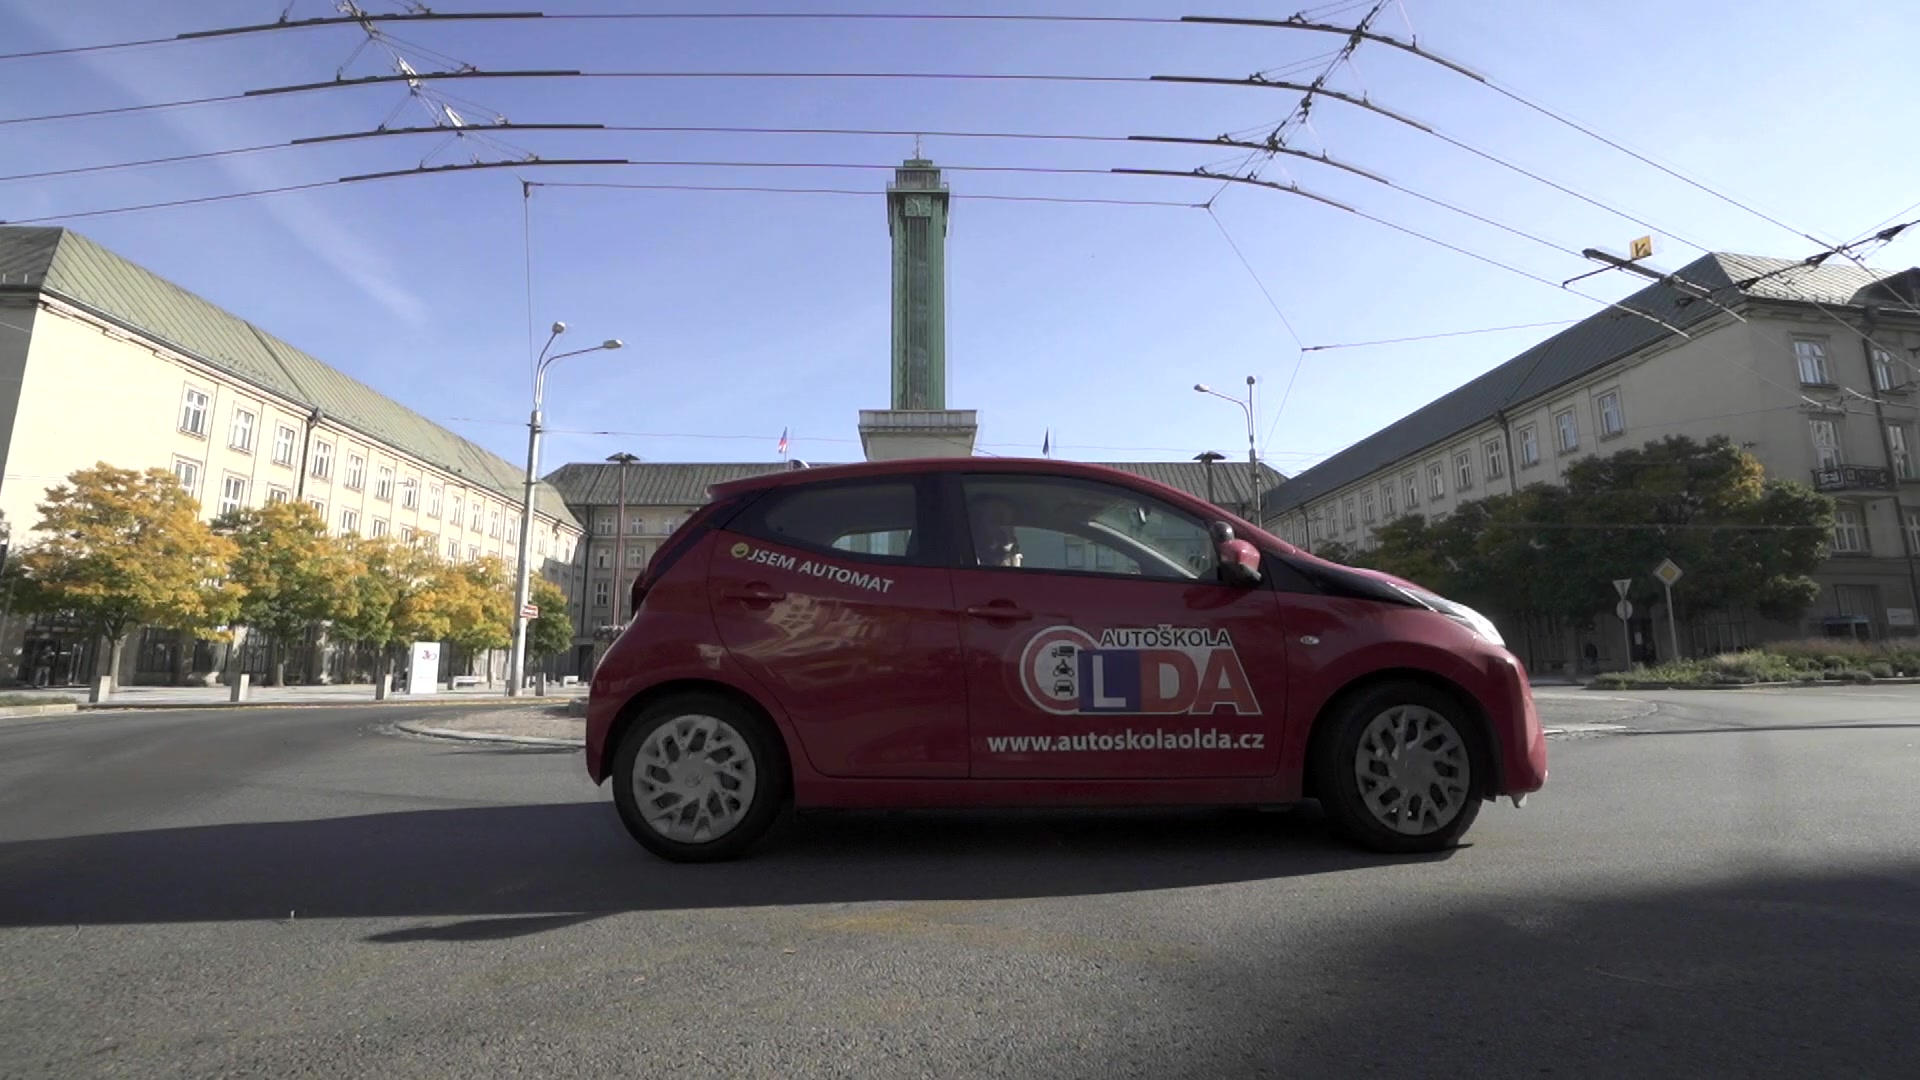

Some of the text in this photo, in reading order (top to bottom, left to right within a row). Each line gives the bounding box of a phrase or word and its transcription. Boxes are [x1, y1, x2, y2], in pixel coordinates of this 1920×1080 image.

[747, 549, 894, 593] JSEM AUTOMAT
[1101, 625, 1231, 647] AUTOŠKOLA
[987, 728, 1264, 753] www.autoskolaolda.cz
